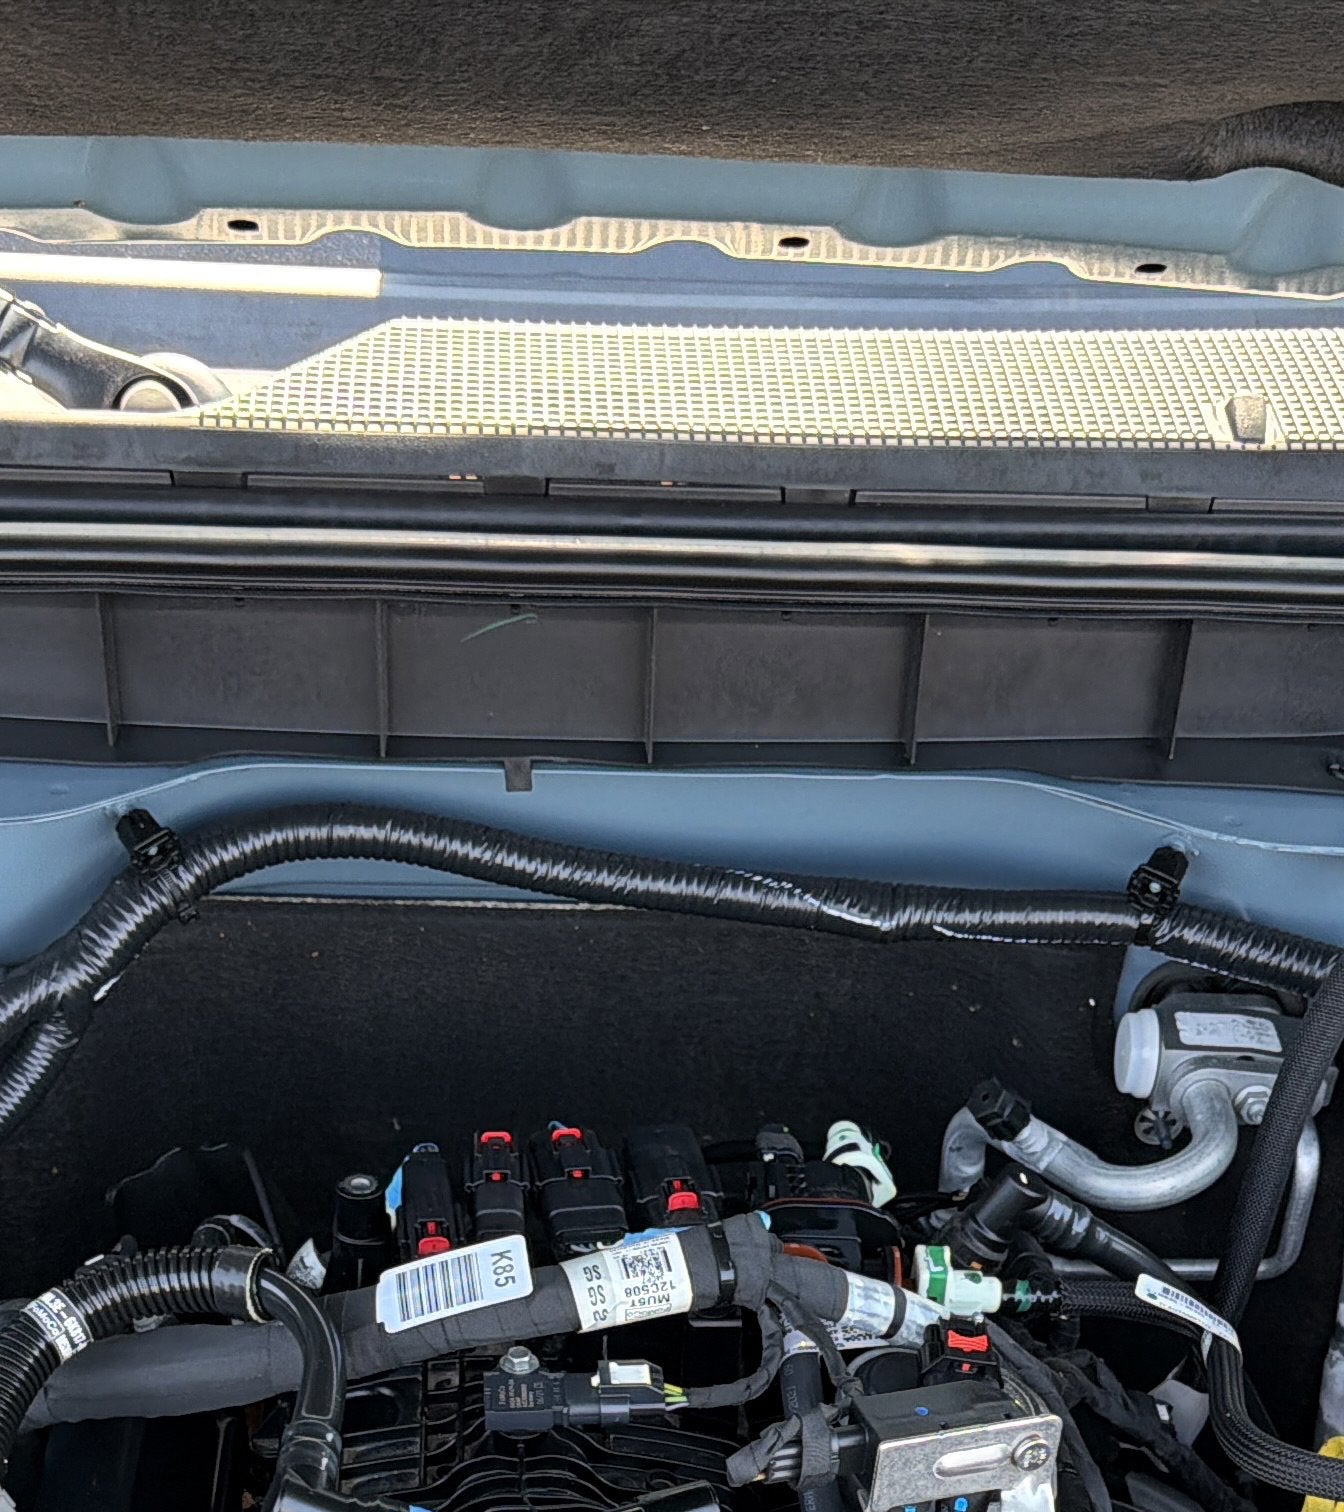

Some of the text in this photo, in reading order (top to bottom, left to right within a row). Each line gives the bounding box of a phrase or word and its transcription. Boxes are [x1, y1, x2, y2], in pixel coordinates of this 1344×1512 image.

[489, 1247, 517, 1290] K85
[582, 1264, 601, 1282] SG
[587, 1284, 606, 1306] SG
[623, 1279, 676, 1298] 12C508
